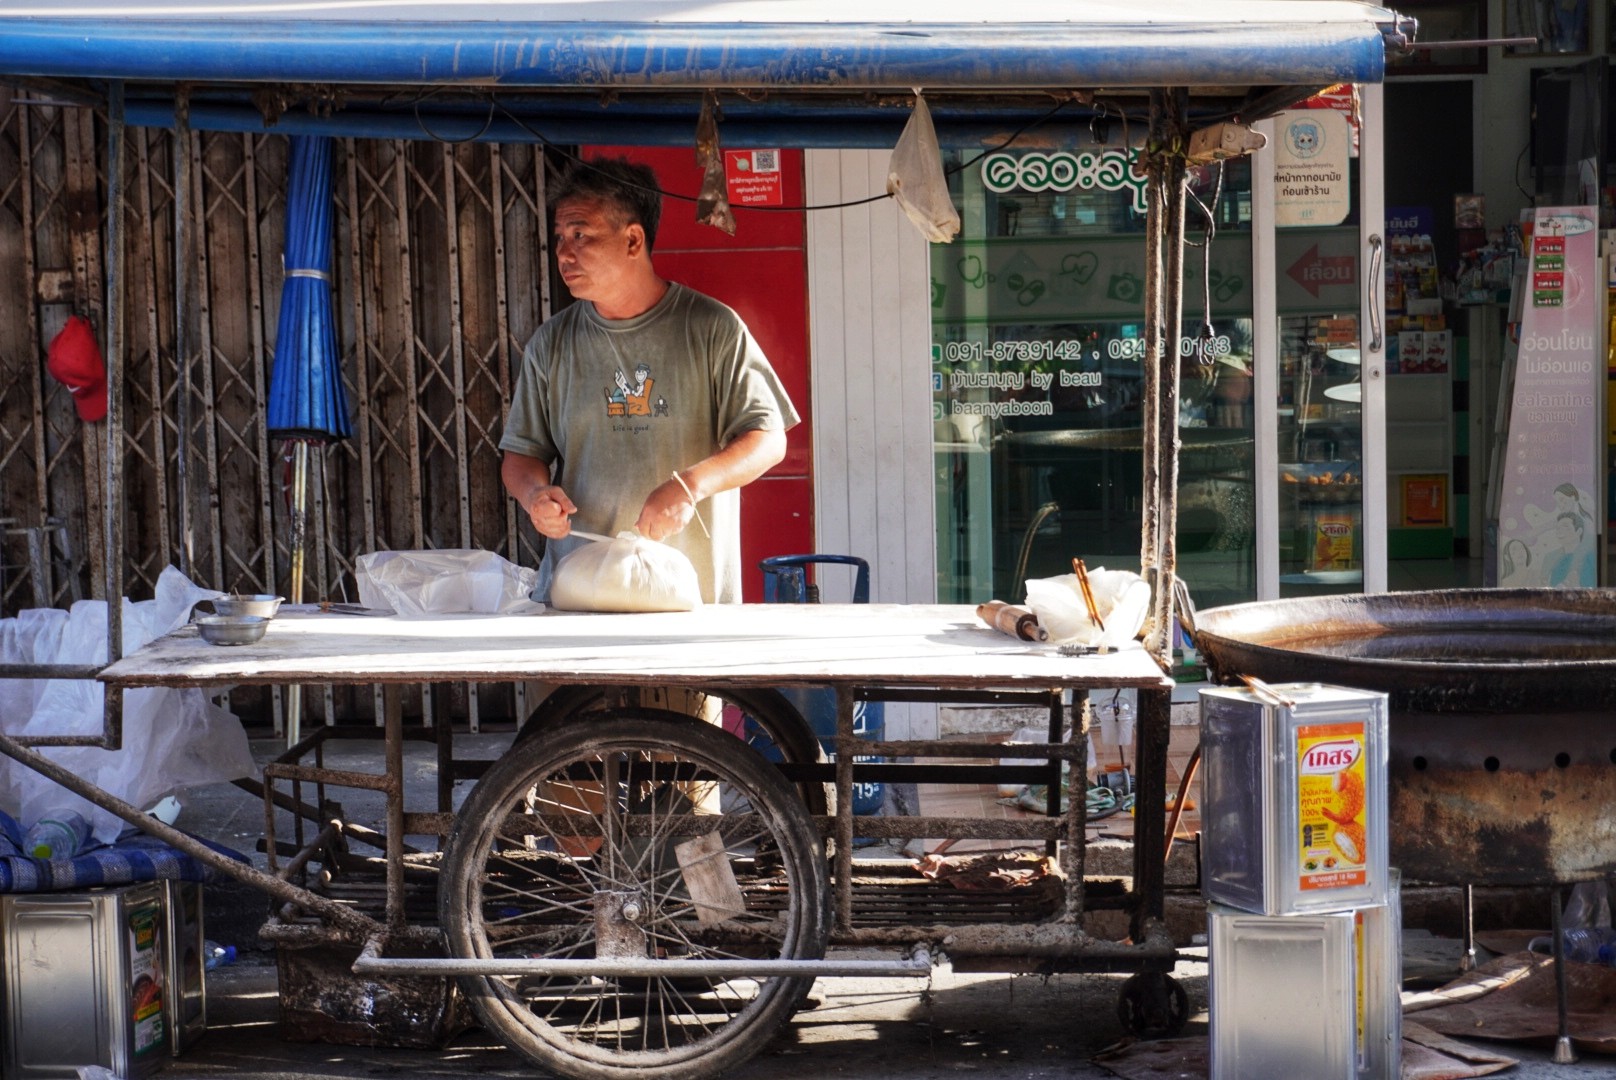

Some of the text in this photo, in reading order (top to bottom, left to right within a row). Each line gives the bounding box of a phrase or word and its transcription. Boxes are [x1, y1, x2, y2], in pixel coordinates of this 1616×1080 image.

[1274, 172, 1342, 183] ส่หน้ากากอนามัย
[1282, 185, 1330, 196] ก่อนเข้าร้าน
[1303, 259, 1351, 281] เลื่อน
[1523, 328, 1594, 351] อ่อนโยน
[946, 340, 1081, 362] 091-8739142
[1522, 355, 1592, 373] ไม่อ่อนแอ
[951, 369, 1102, 391] บ้านยาบุญ by beau
[952, 399, 1053, 419] baanyaboon
[1515, 391, 1594, 408] Calamine
[1308, 749, 1353, 768] เกสร
